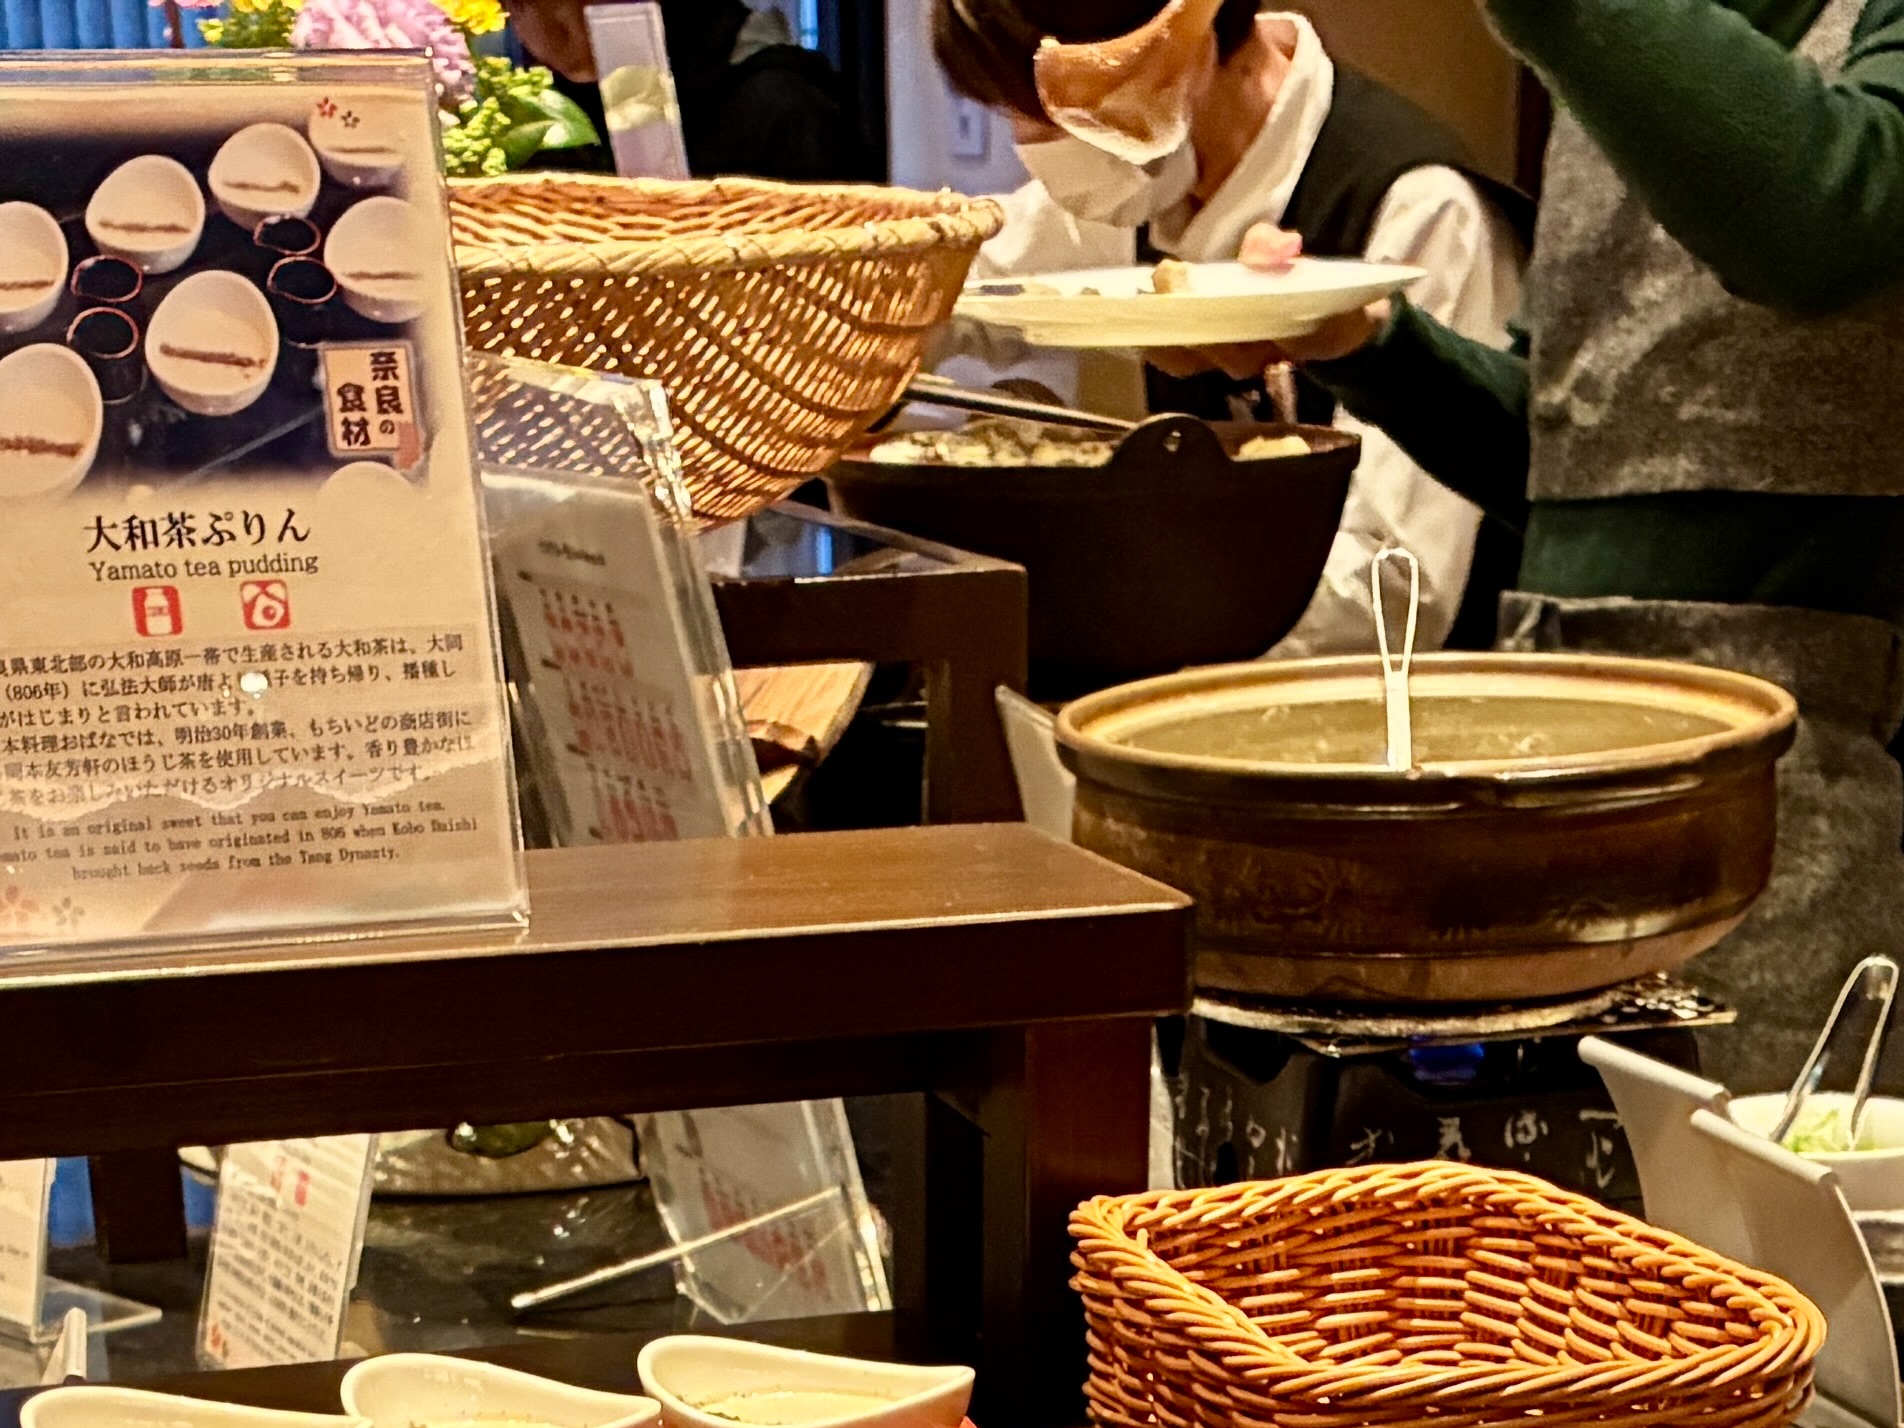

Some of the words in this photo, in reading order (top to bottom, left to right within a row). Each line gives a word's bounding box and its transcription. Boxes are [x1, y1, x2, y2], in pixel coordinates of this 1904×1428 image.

[369, 351, 404, 435] 奈良の
[337, 382, 371, 447] 食材
[83, 508, 311, 553] 大和茶ぷりん
[89, 560, 178, 582] Yamato
[185, 558, 221, 577] tea
[228, 552, 319, 579] pudding
[14, 826, 29, 840] It
[87, 816, 152, 836] original
[251, 811, 275, 826] you
[315, 805, 355, 820] enjoy
[363, 801, 411, 817] Yamato
[209, 829, 290, 849] originated
[299, 829, 315, 843] in
[392, 821, 425, 836] Kobo
[228, 854, 261, 870] from
[268, 852, 292, 866] the
